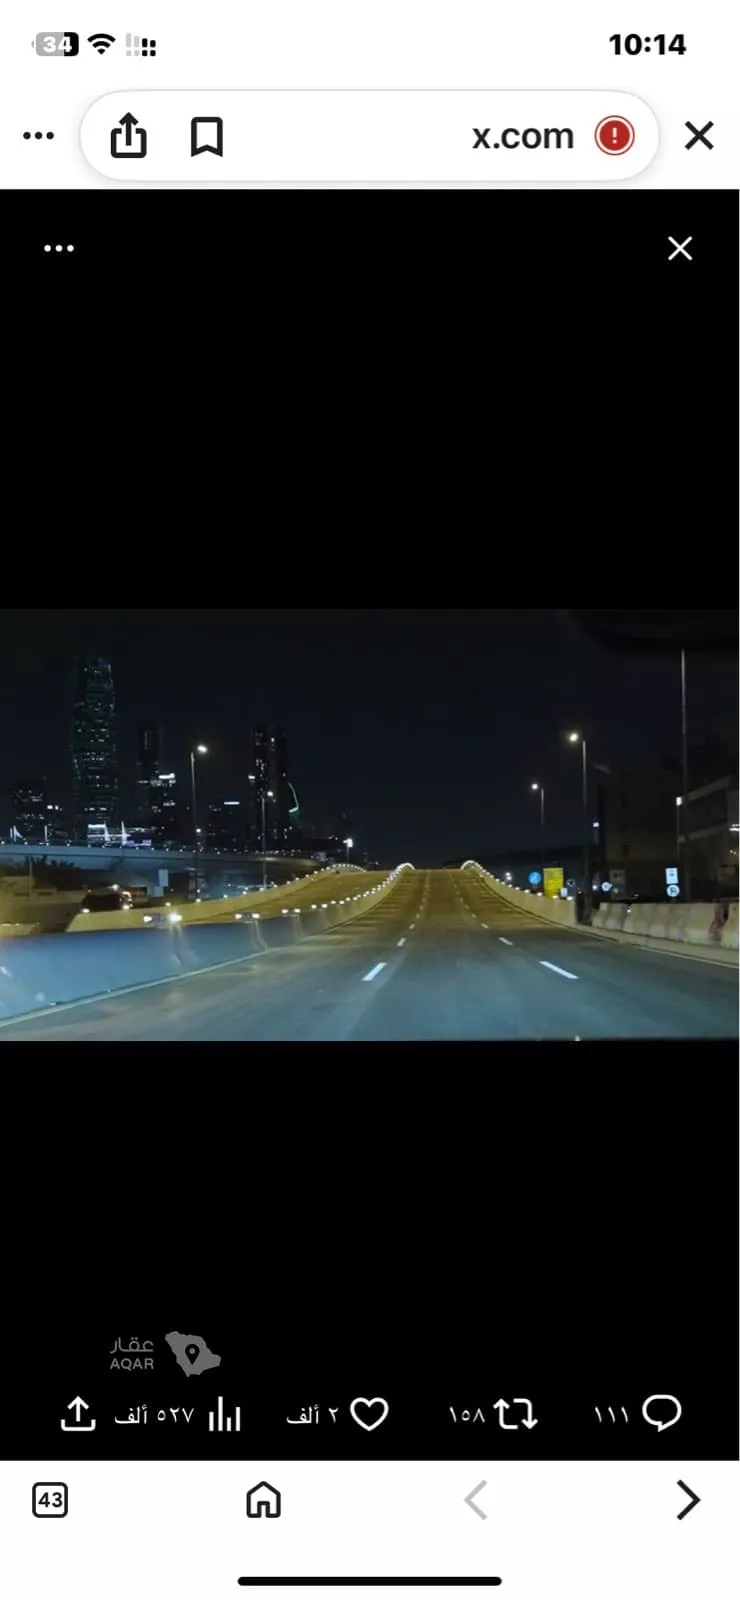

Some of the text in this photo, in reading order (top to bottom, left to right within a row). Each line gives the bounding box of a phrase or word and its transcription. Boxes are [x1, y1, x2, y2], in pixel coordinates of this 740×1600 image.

[43, 36, 73, 53] 34
[609, 33, 687, 56] 10:14
[472, 127, 574, 150] x.com
[114, 1404, 195, 1425] ٥٢٧ ألف
[286, 1404, 339, 1425] ٢ ألف
[449, 1406, 486, 1423] ١٥٨
[594, 1406, 629, 1423] ١١١
[38, 1491, 63, 1508] 43
